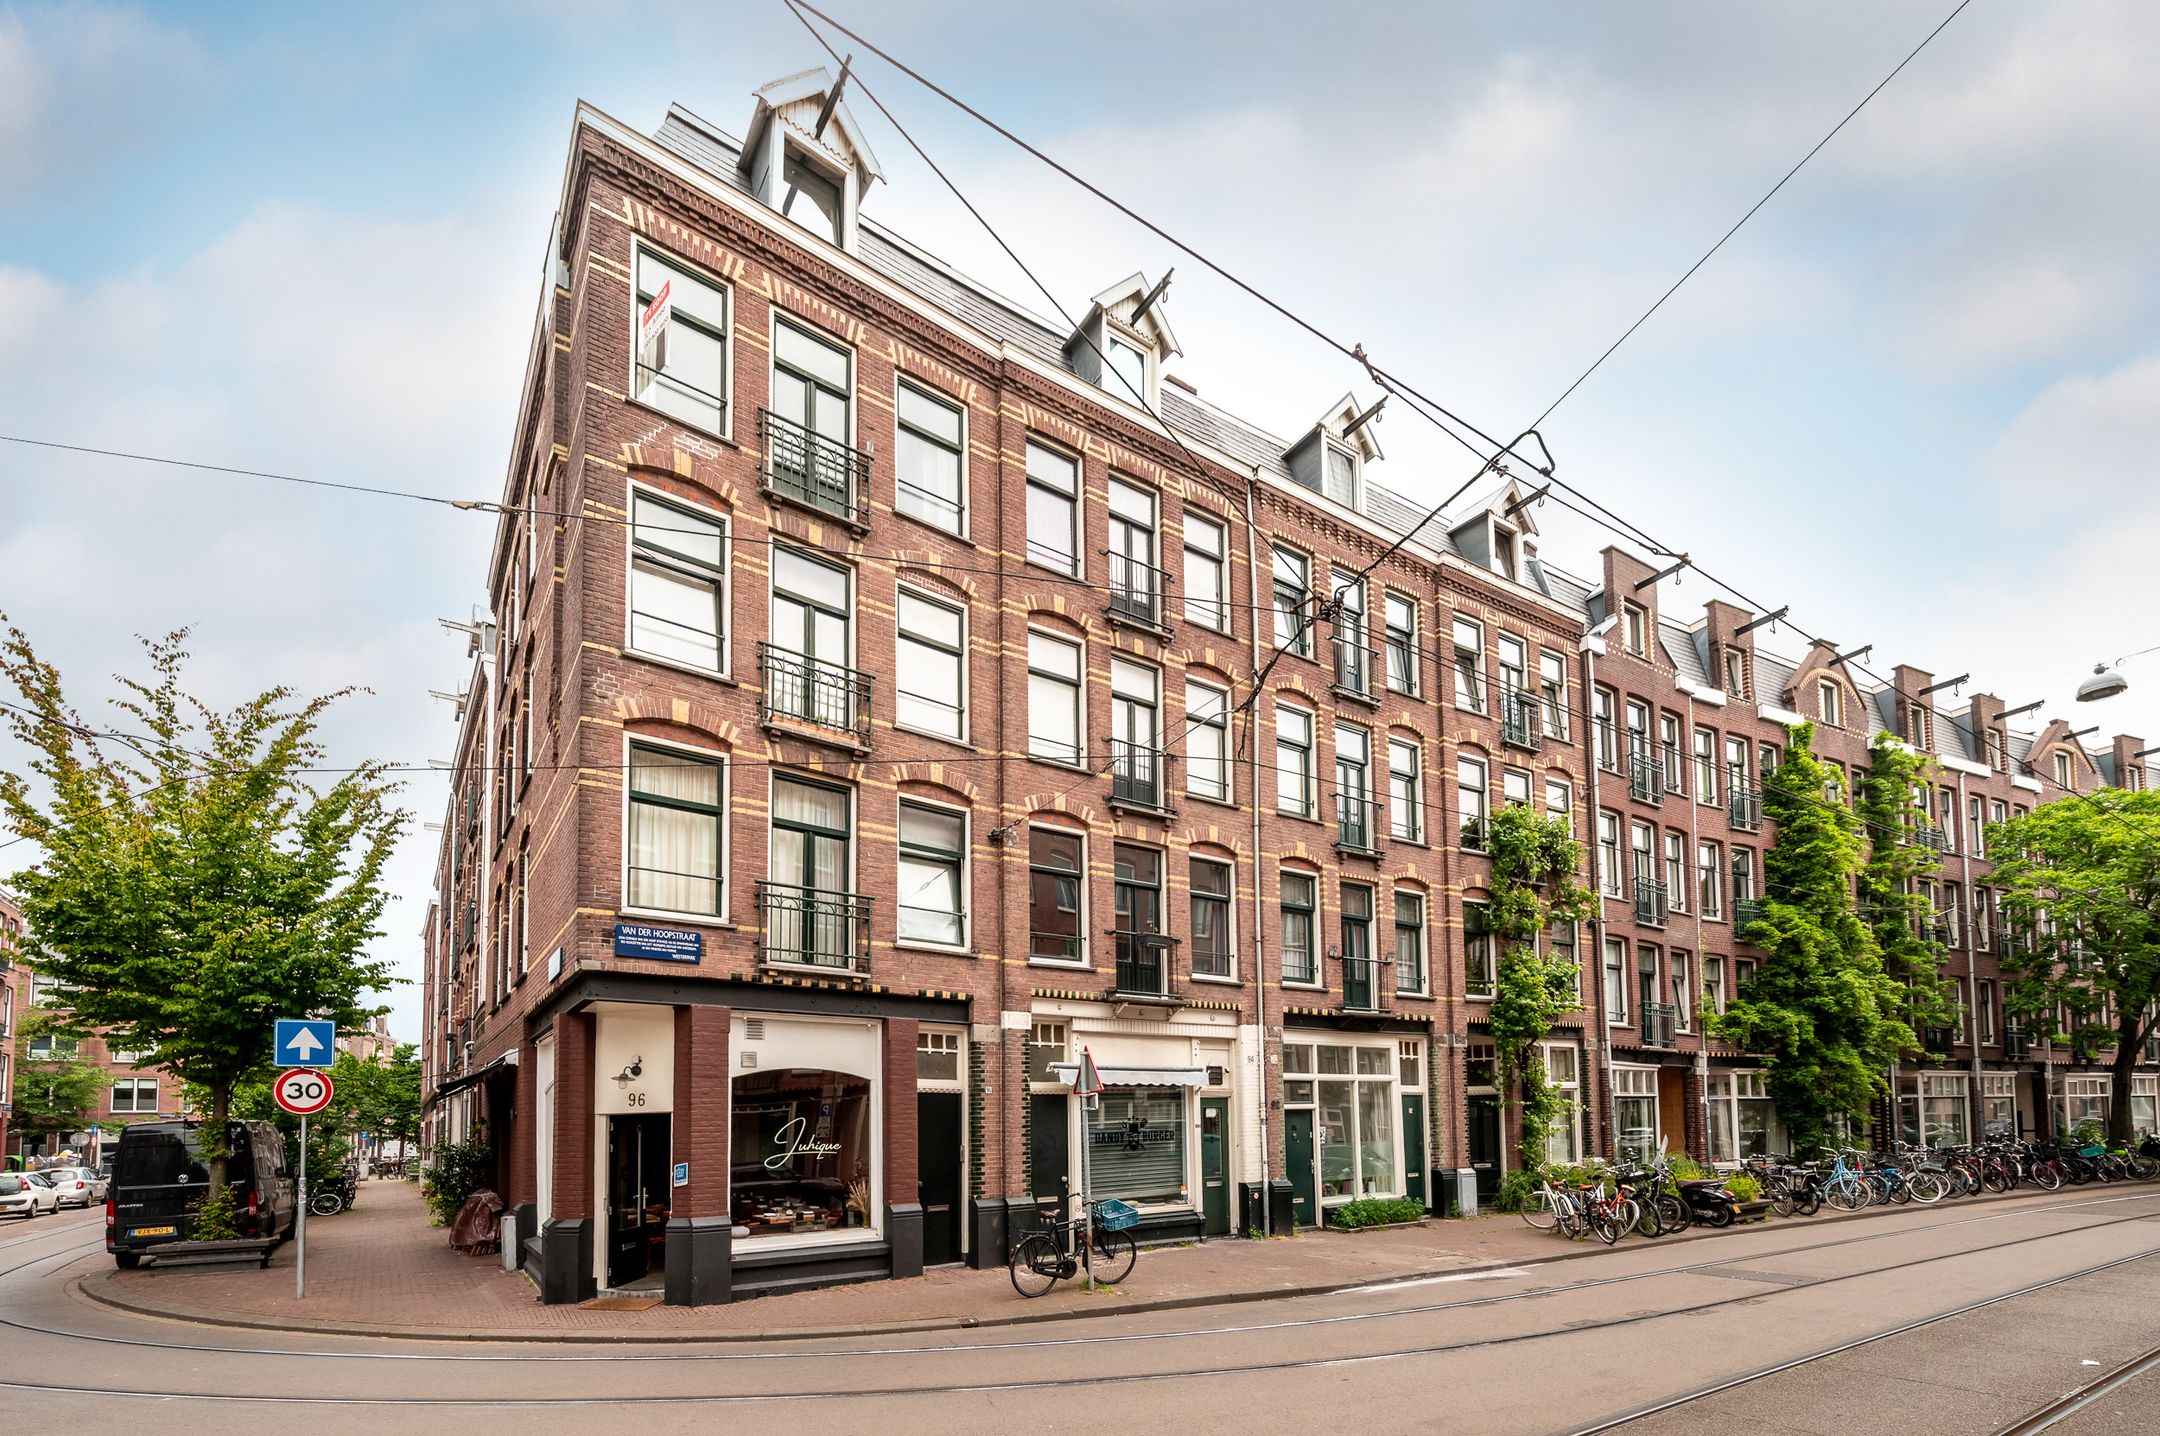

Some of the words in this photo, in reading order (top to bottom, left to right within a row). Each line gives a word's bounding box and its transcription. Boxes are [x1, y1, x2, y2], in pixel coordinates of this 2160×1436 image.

[621, 926, 636, 935] VAN
[638, 927, 652, 937] DER
[653, 929, 697, 941] HOOPSTRAAT
[286, 1082, 323, 1100] 30
[628, 1092, 646, 1107] 96
[764, 1116, 842, 1169] Juhique
[1095, 1131, 1126, 1145] DANDY
[1141, 1130, 1176, 1142] BURGER
